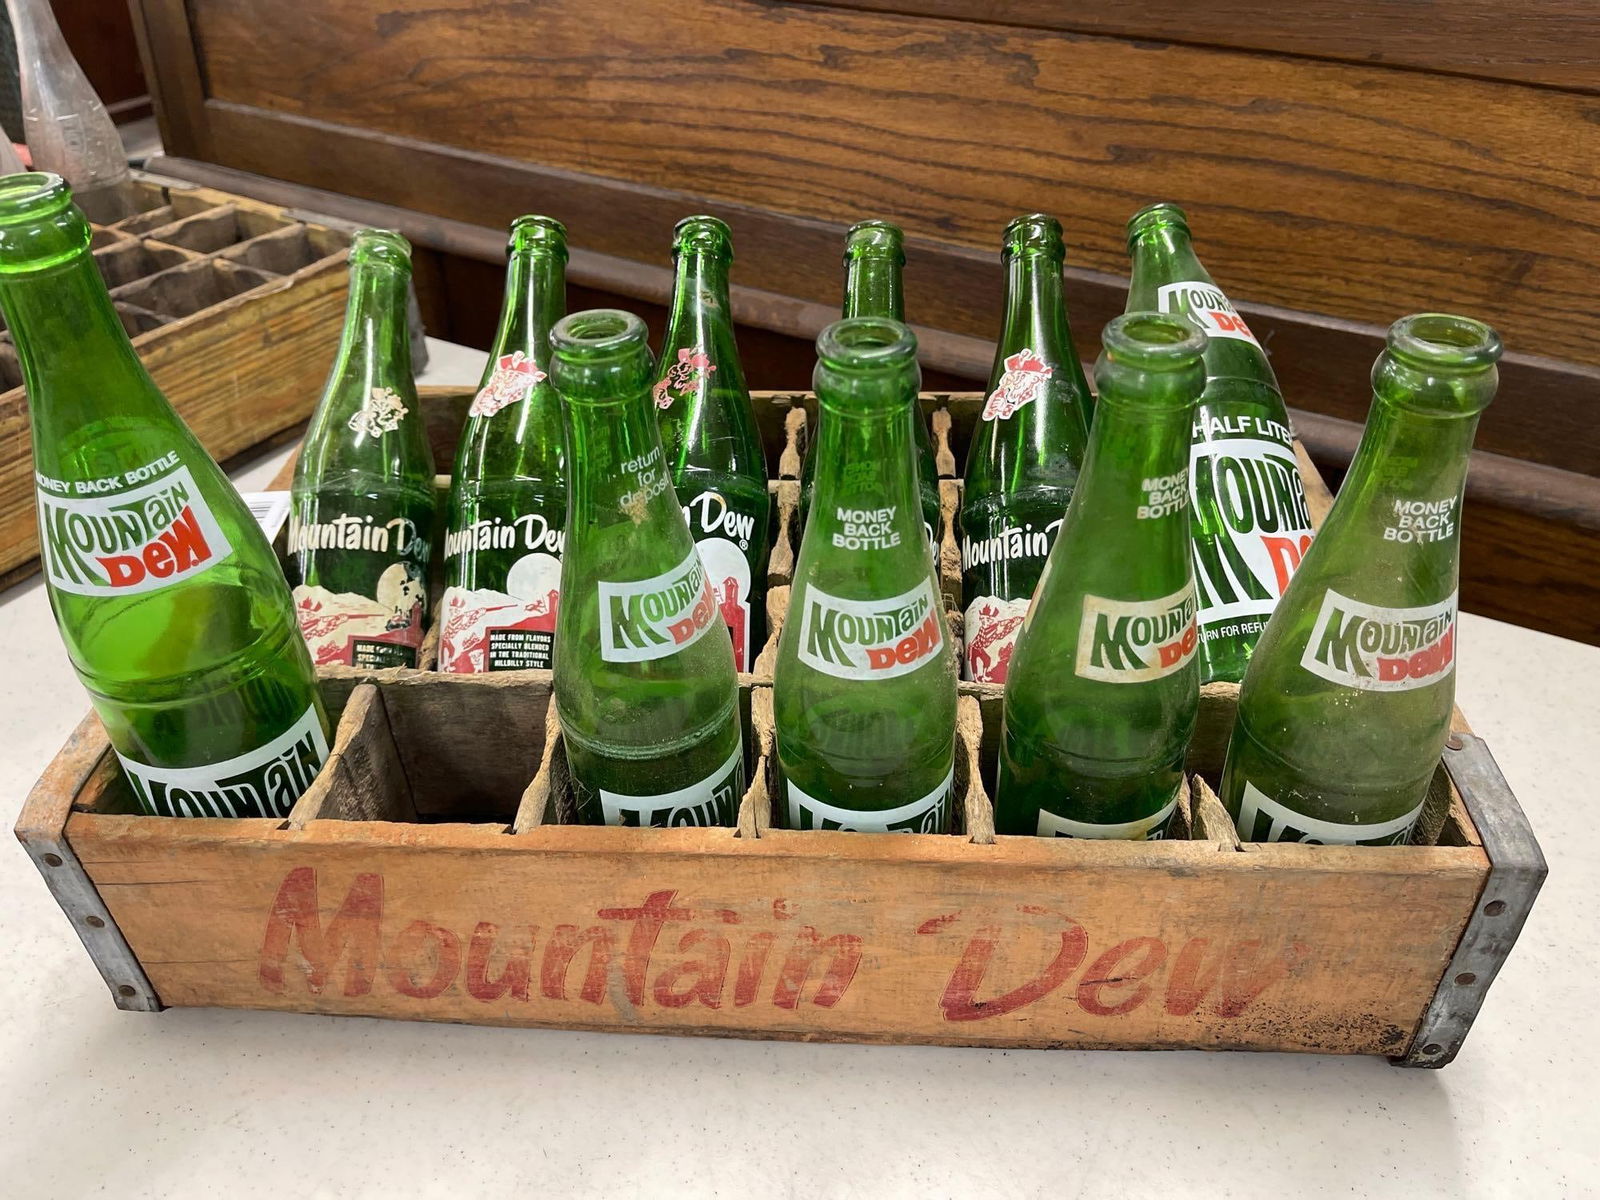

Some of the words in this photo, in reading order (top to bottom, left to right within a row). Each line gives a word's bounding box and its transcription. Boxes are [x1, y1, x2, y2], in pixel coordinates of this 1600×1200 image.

[1192, 416, 1251, 439] HALF
[1255, 417, 1293, 447] LITE
[621, 446, 661, 474] return
[75, 474, 124, 494] BACK
[124, 450, 181, 485] BOTTLE
[637, 468, 656, 487] for
[1149, 483, 1187, 506] BACK
[1394, 496, 1458, 515] MONEY
[690, 491, 755, 541] Dew
[837, 506, 897, 525] MONEY
[1399, 511, 1449, 528] BACK
[287, 513, 389, 556] Mountain
[844, 521, 892, 537] BACK
[1383, 524, 1454, 544] BOTTLE
[832, 532, 901, 550] BOTTLE
[962, 524, 1048, 573] Mountain
[526, 634, 551, 643] FLAVORS
[1220, 625, 1239, 638] FOR
[491, 642, 522, 650] SPECIALLY
[523, 643, 550, 651] BLENDED
[511, 651, 549, 660] TRADITIONAL
[494, 659, 523, 667] HILLBILLY
[525, 660, 544, 668] STYLE
[258, 867, 863, 1012] Mountain
[914, 903, 1310, 1023] Dew
